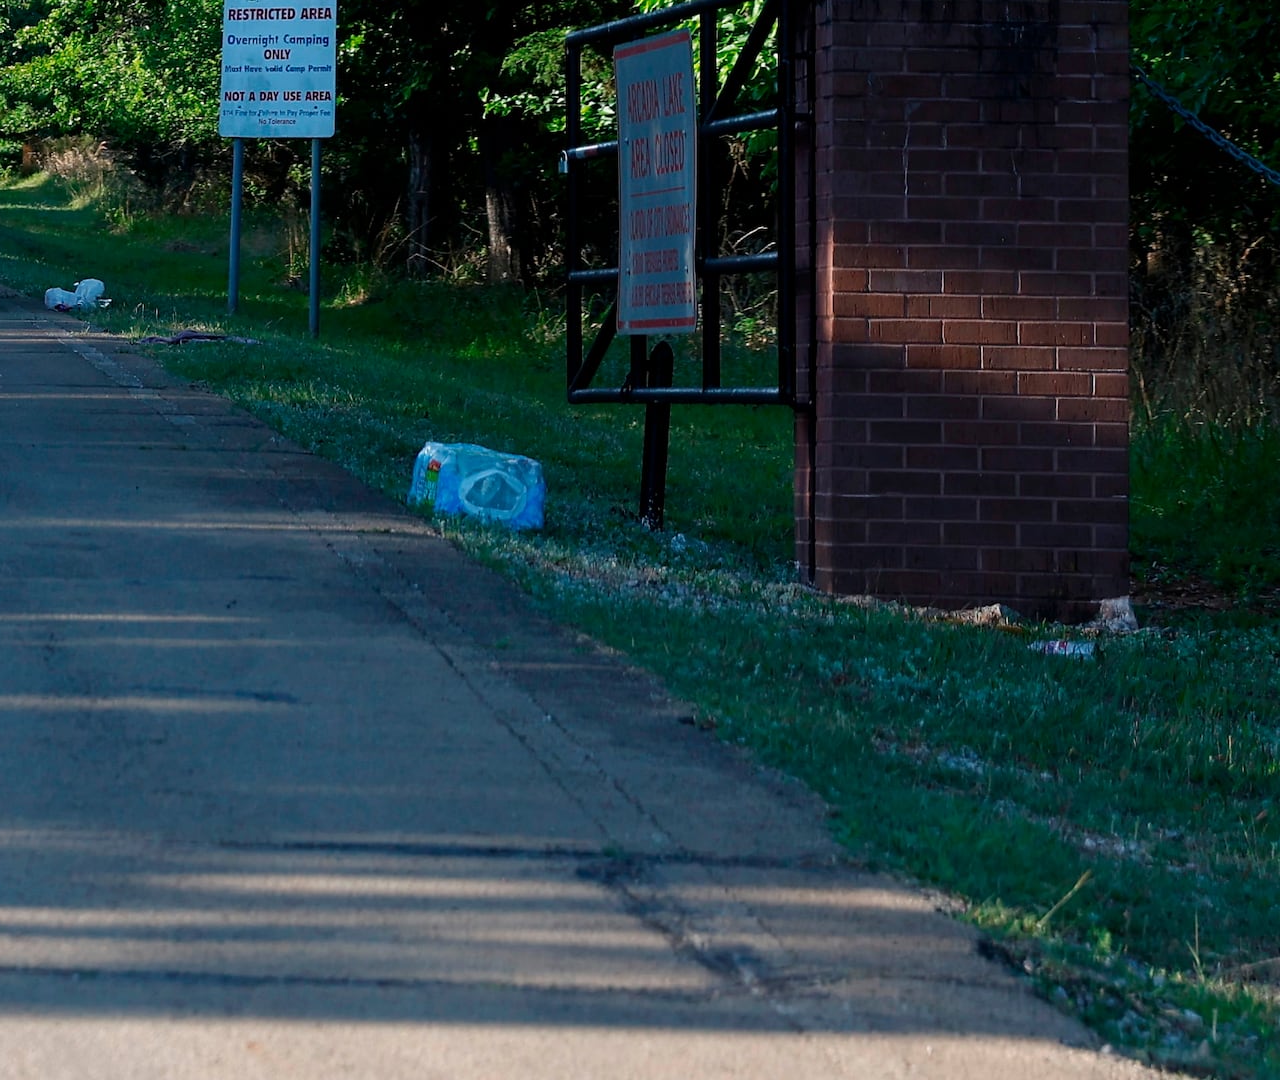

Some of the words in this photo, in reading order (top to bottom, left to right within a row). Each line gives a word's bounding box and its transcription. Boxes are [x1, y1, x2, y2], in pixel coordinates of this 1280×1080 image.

[228, 8, 296, 20] RESTRICTED
[300, 8, 332, 20] AREA
[227, 34, 279, 47] Overnight
[283, 34, 329, 47] Camping
[263, 49, 291, 60] ONLY
[286, 65, 305, 74] Camp
[308, 65, 332, 73] Permit
[224, 91, 245, 101] NOT
[249, 91, 256, 101] A
[260, 91, 279, 101] DAY
[283, 91, 301, 101] USE
[305, 91, 332, 101] AREA
[627, 80, 660, 124] ARCADIA
[662, 72, 686, 117] LAKE
[630, 137, 651, 179] AREA
[655, 130, 685, 175] CLOSED
